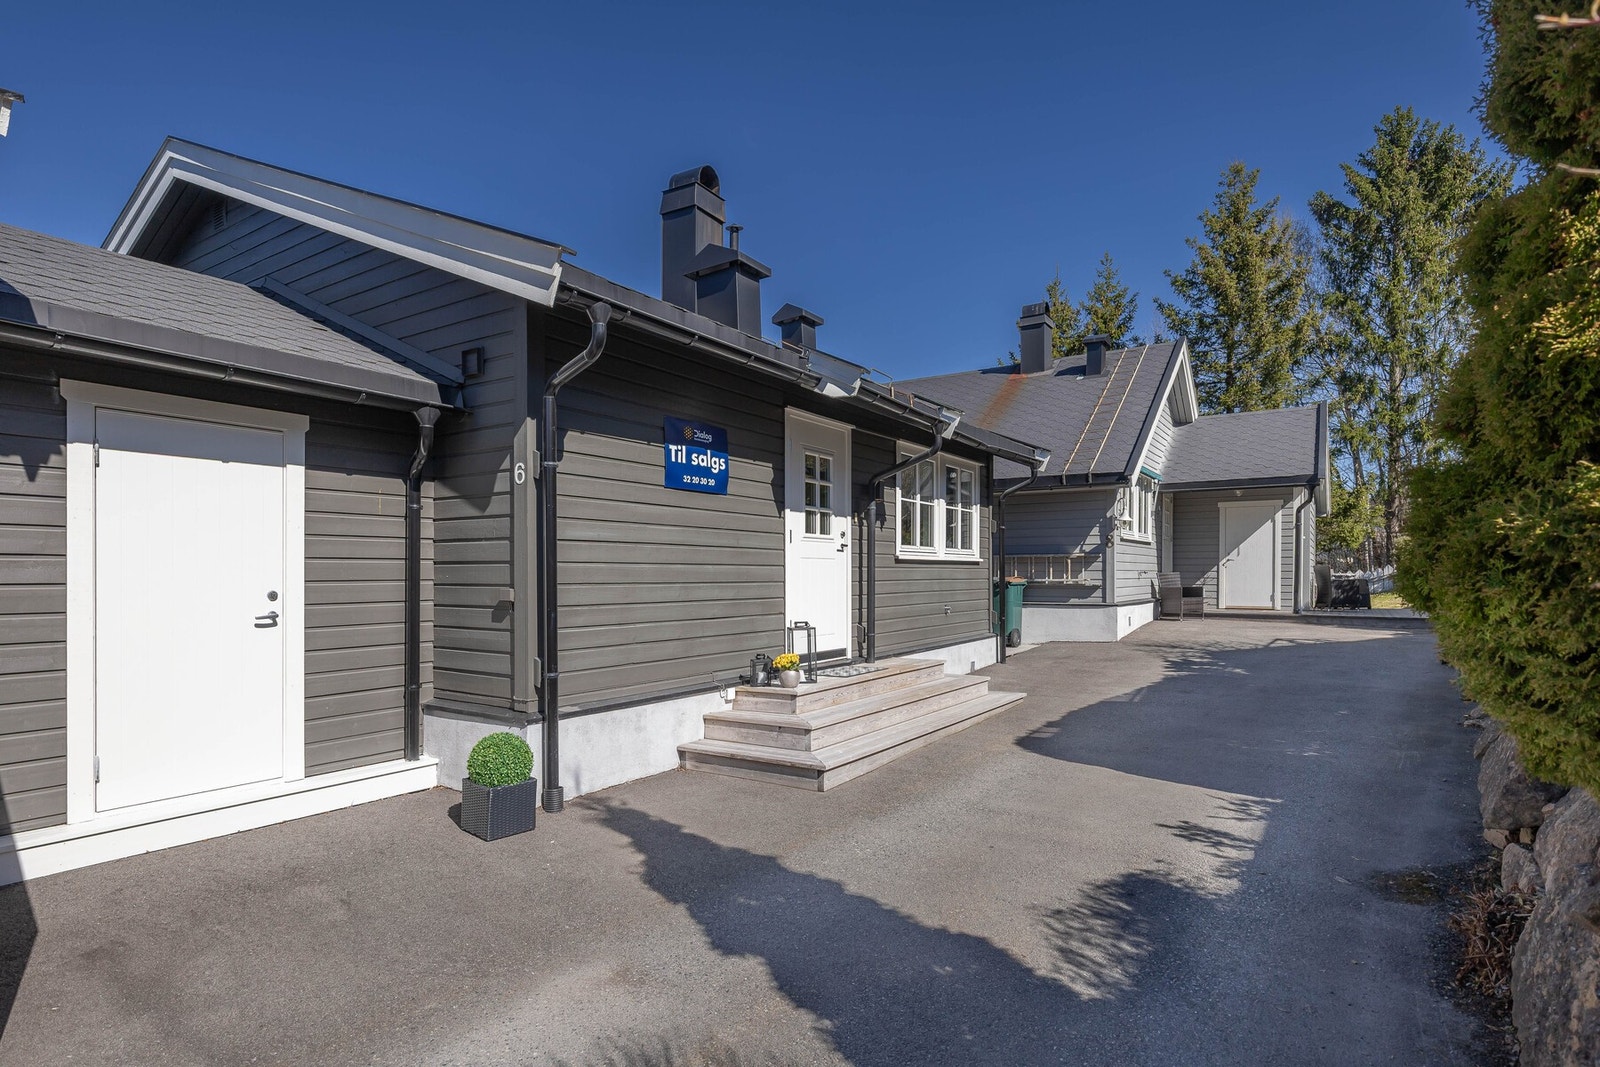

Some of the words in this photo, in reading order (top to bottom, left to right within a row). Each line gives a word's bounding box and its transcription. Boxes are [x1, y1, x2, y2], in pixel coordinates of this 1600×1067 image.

[694, 429, 712, 442] Dialog
[669, 444, 686, 463] Til
[691, 450, 726, 473] salgs
[514, 462, 525, 484] 6
[692, 476, 700, 484] 20
[700, 477, 708, 485] 30
[708, 478, 716, 486] 20
